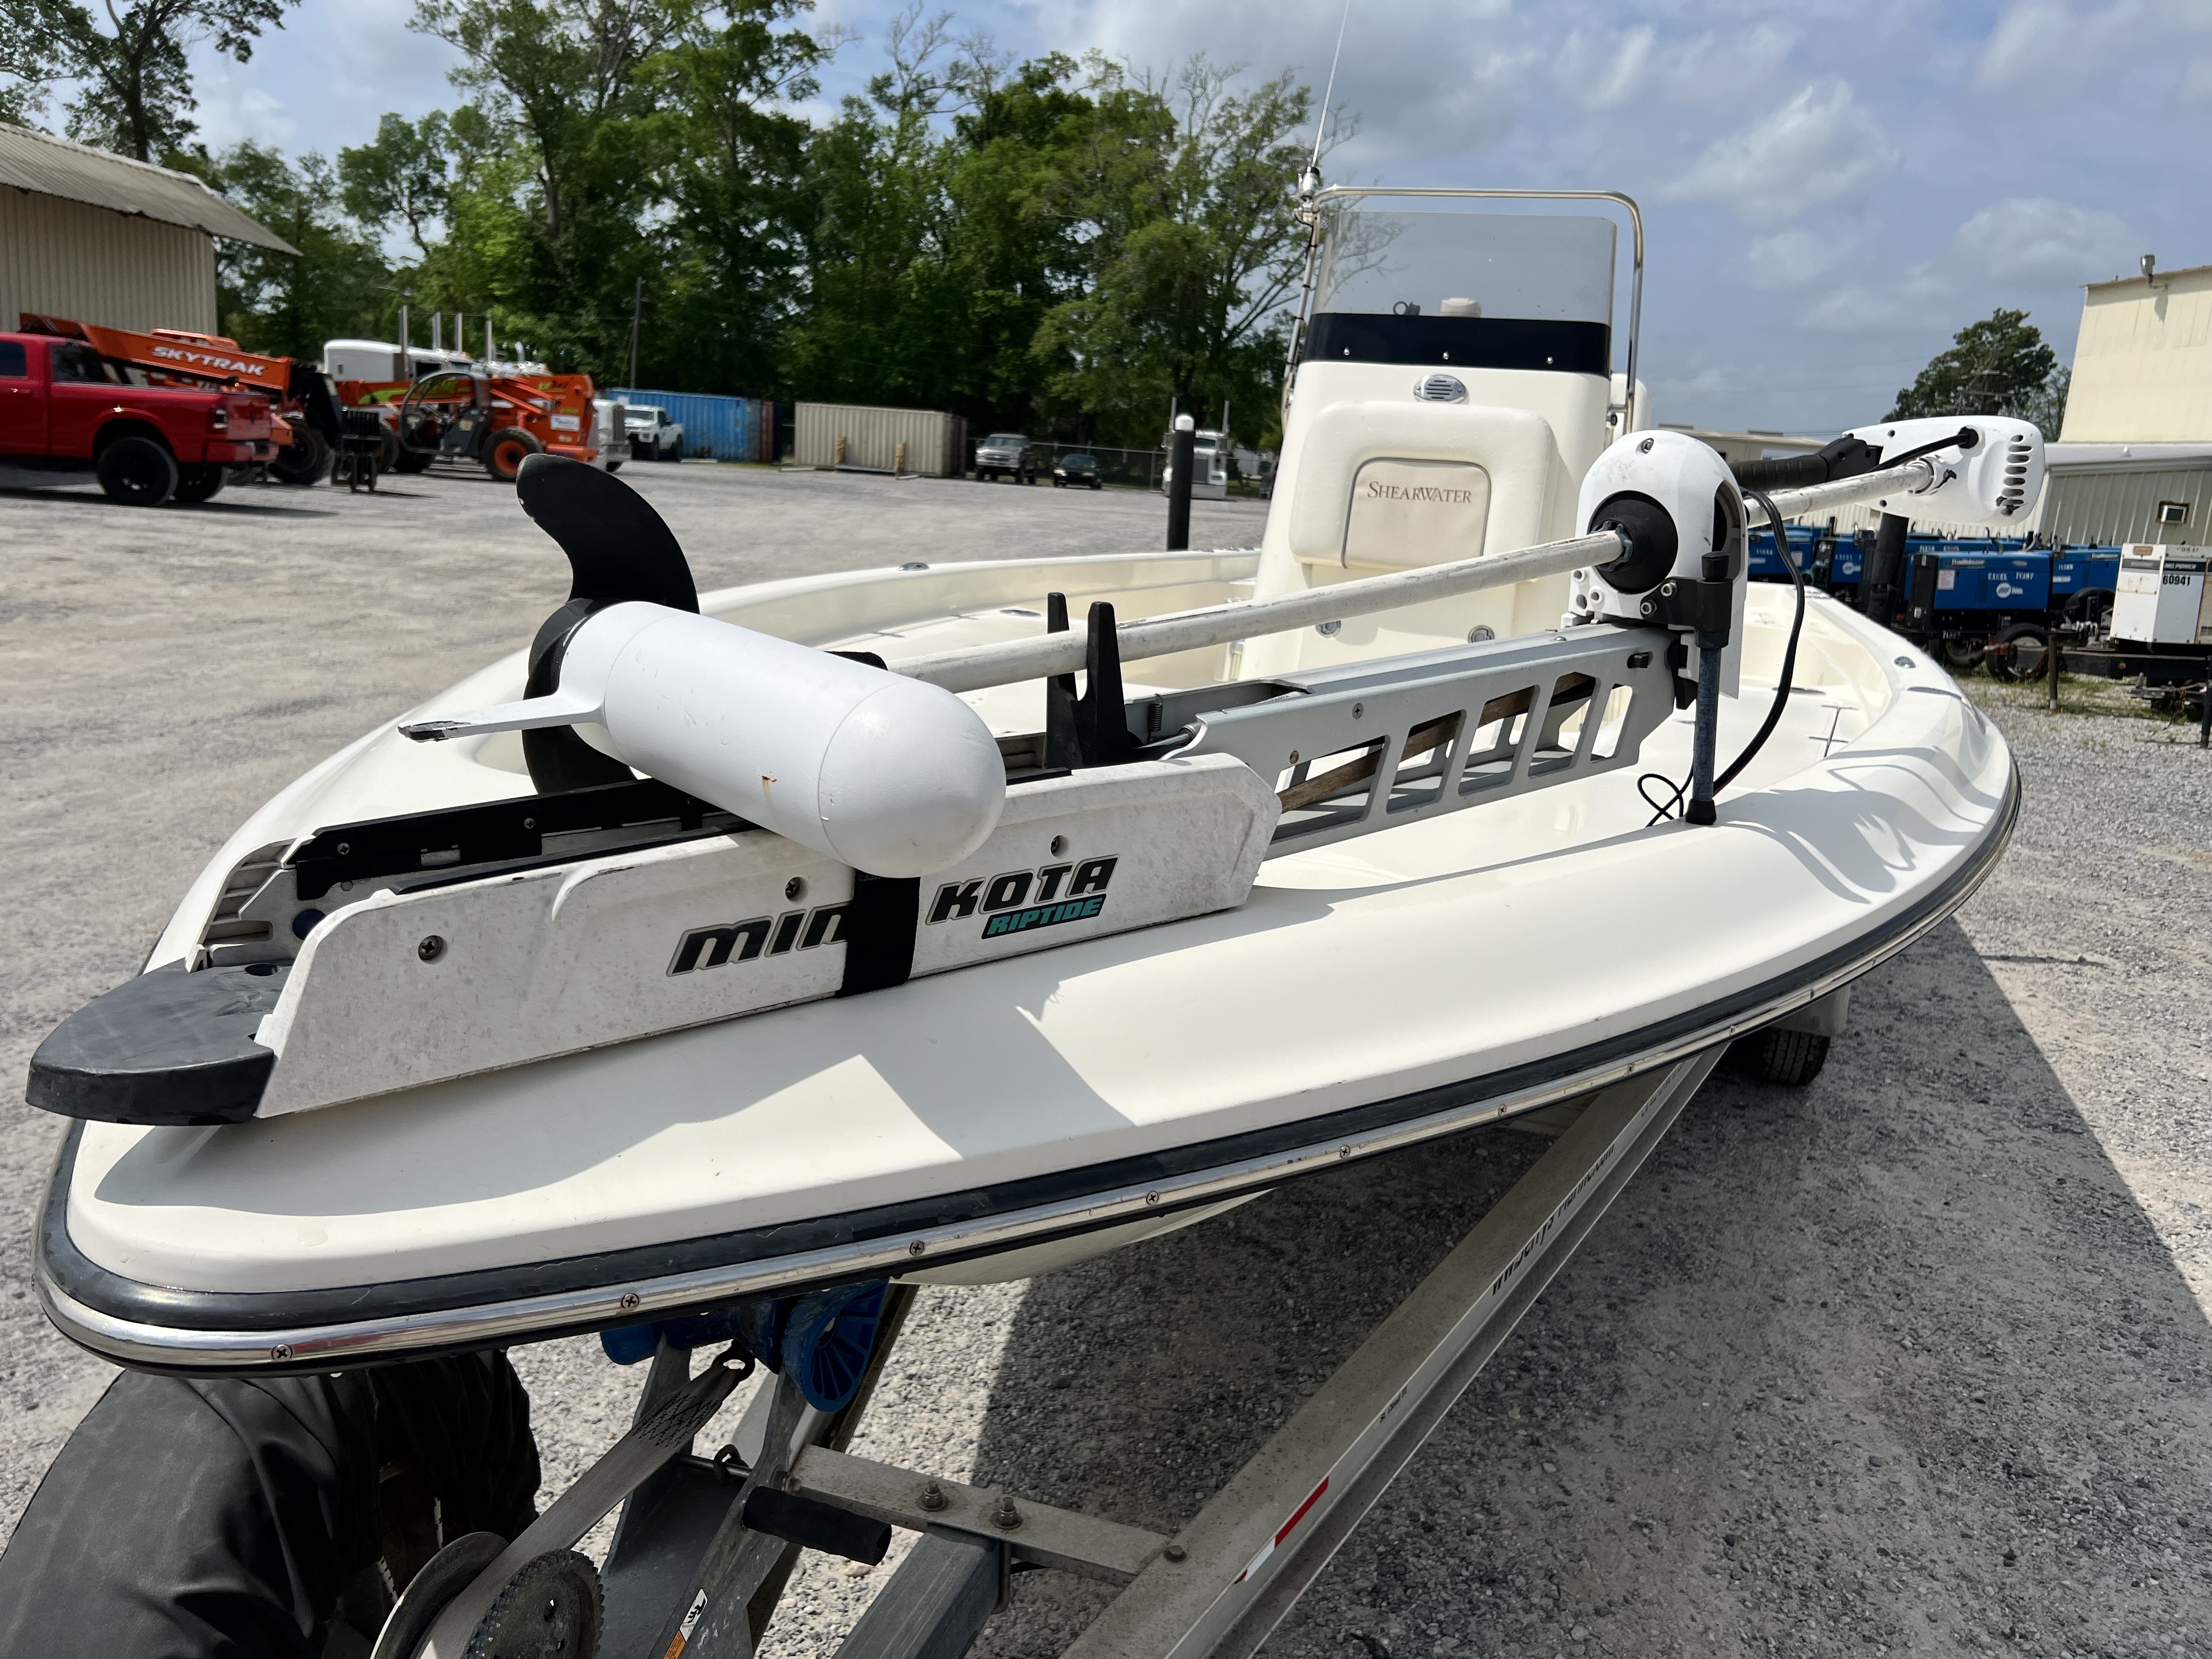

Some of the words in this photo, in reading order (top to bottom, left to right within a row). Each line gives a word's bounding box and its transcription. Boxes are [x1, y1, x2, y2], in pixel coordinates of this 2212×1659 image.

[153, 346, 266, 377] SKYTRAK
[926, 854, 1120, 926] KOTA
[987, 898, 1104, 935] RIPTIDE
